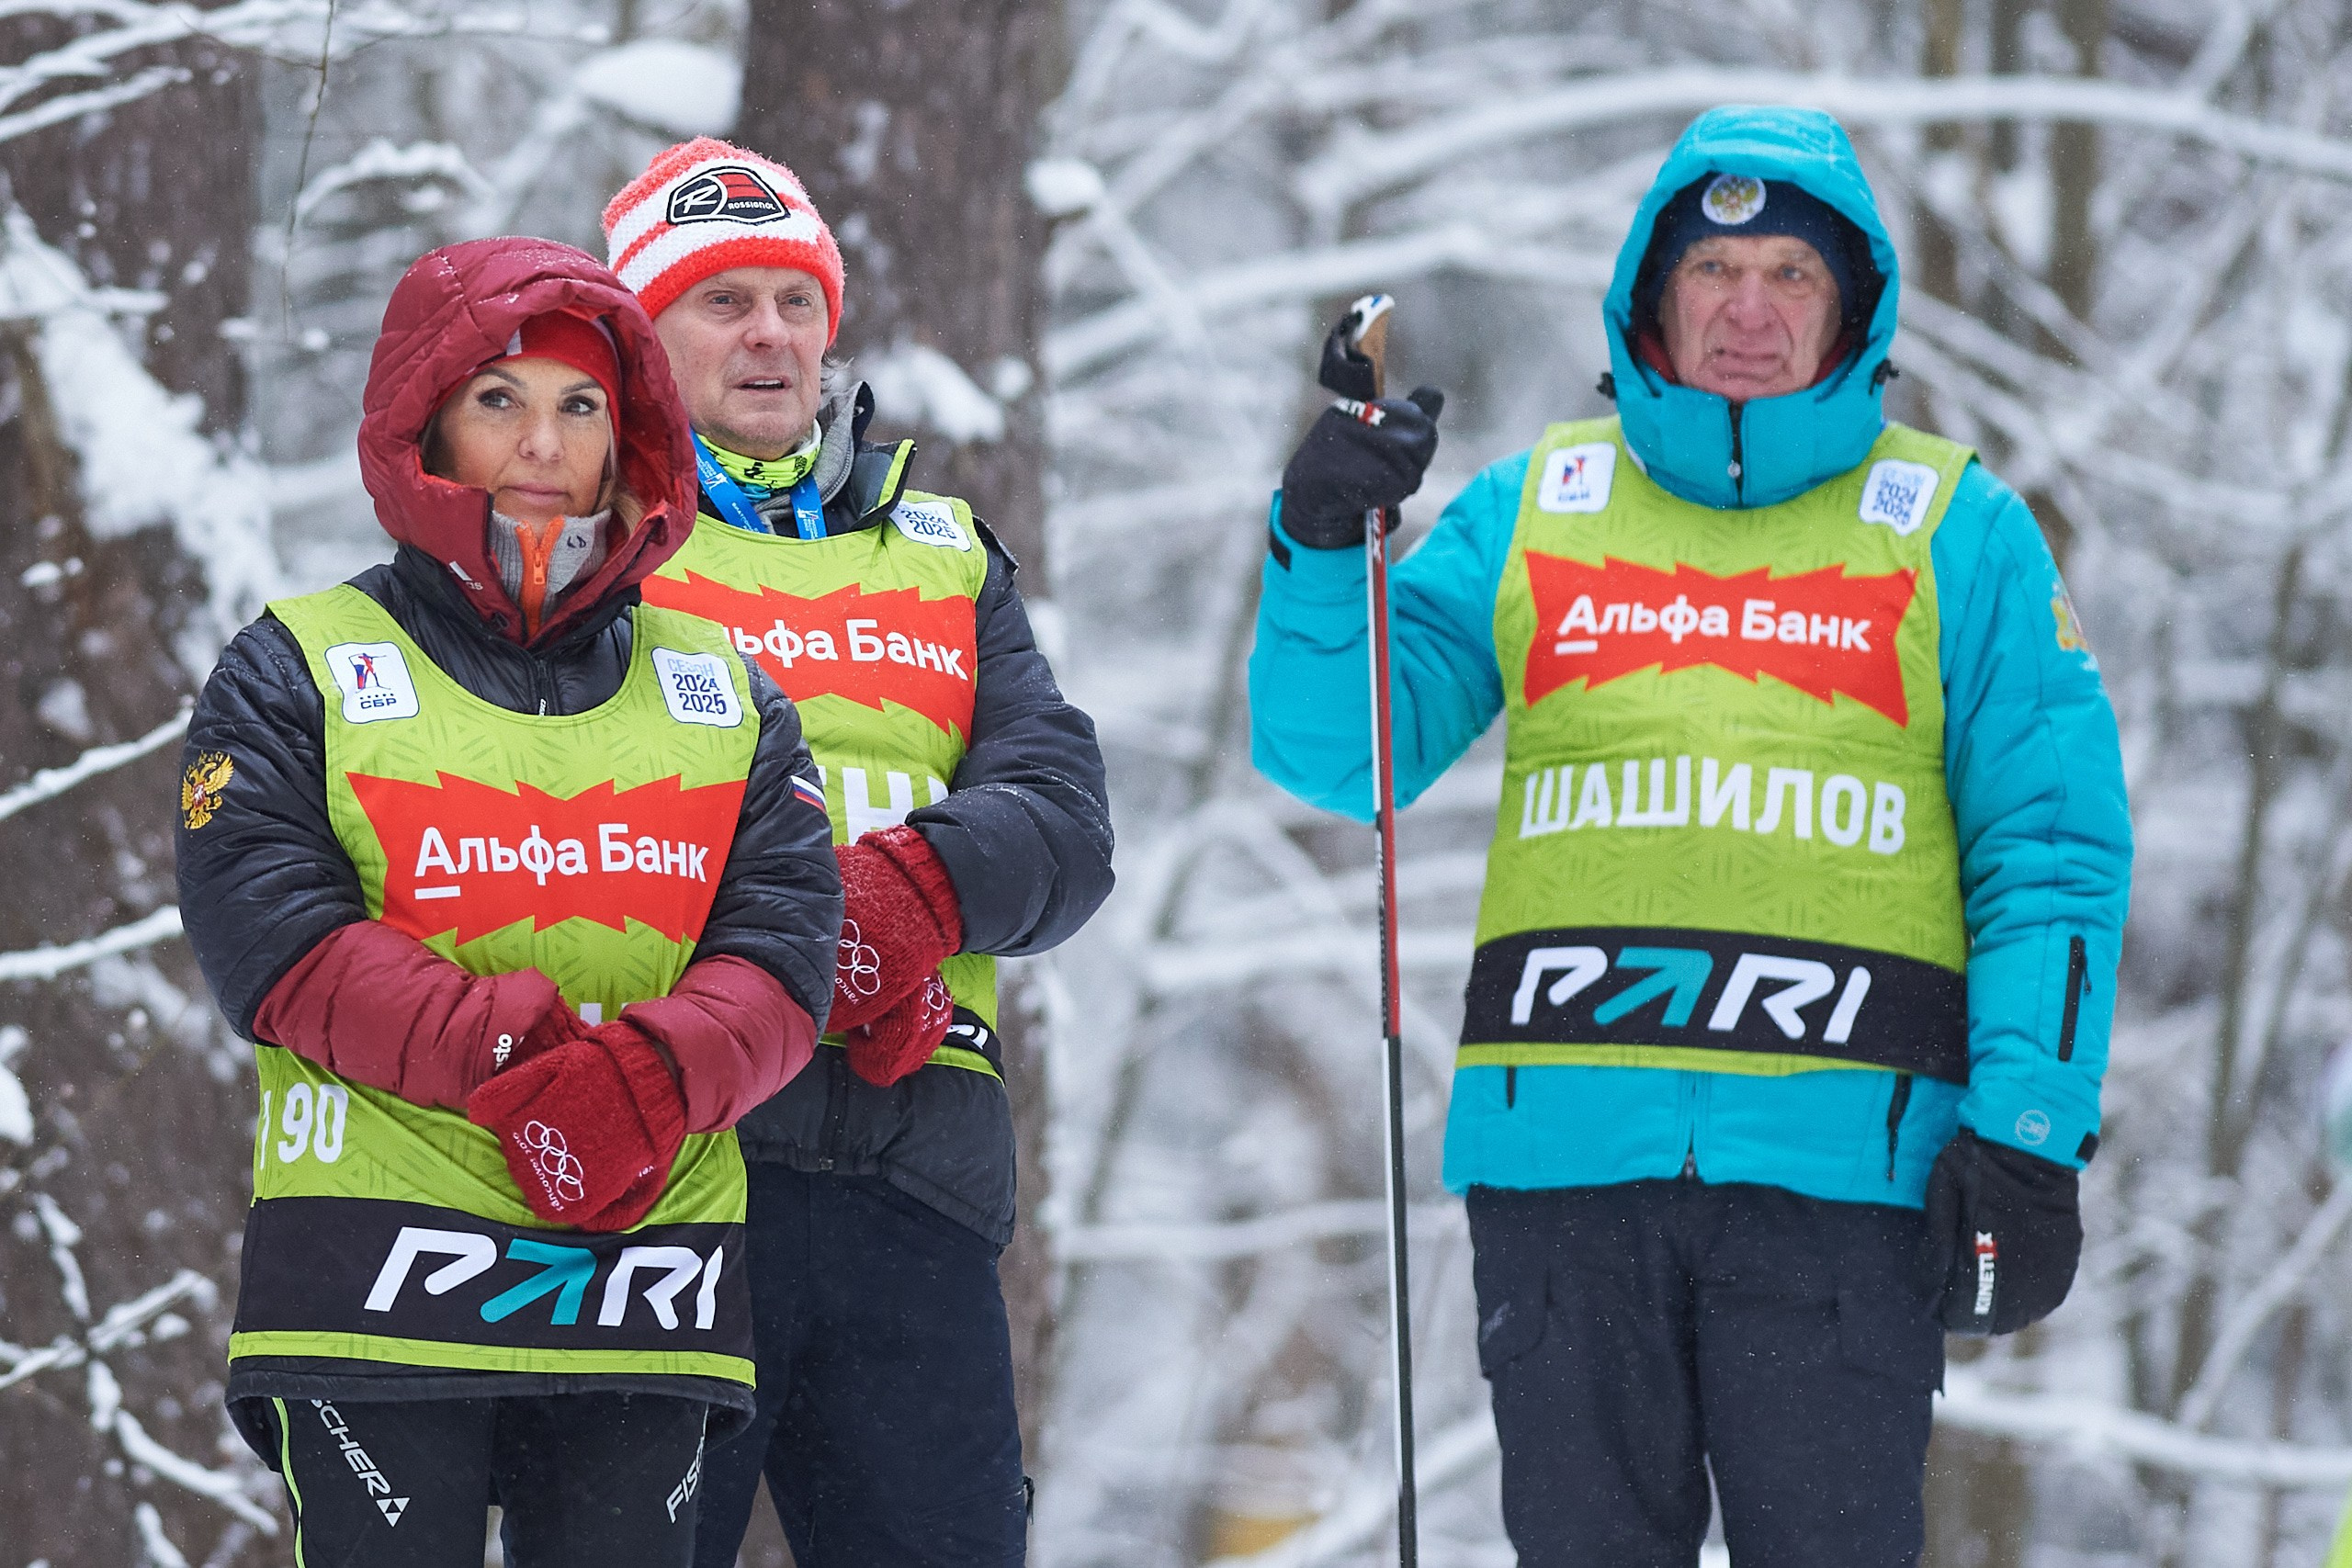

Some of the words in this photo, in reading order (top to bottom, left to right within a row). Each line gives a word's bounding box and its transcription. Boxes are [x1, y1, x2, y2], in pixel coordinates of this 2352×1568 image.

[728, 201, 776, 210] ROSSIGNOL
[909, 520, 957, 539] 2025
[1556, 594, 1729, 644] Альфа
[1741, 599, 1872, 653] Банк
[723, 619, 839, 669] ьфа
[846, 618, 969, 681] Банк
[673, 673, 720, 693] 2024
[360, 697, 397, 709] СБР
[679, 693, 728, 715] 2025
[1519, 755, 1907, 855] ШАШИЛОВ
[414, 824, 588, 886] Альфа
[599, 823, 709, 884] Банк
[835, 974, 860, 1005] vanco
[311, 1399, 391, 1497] CHER
